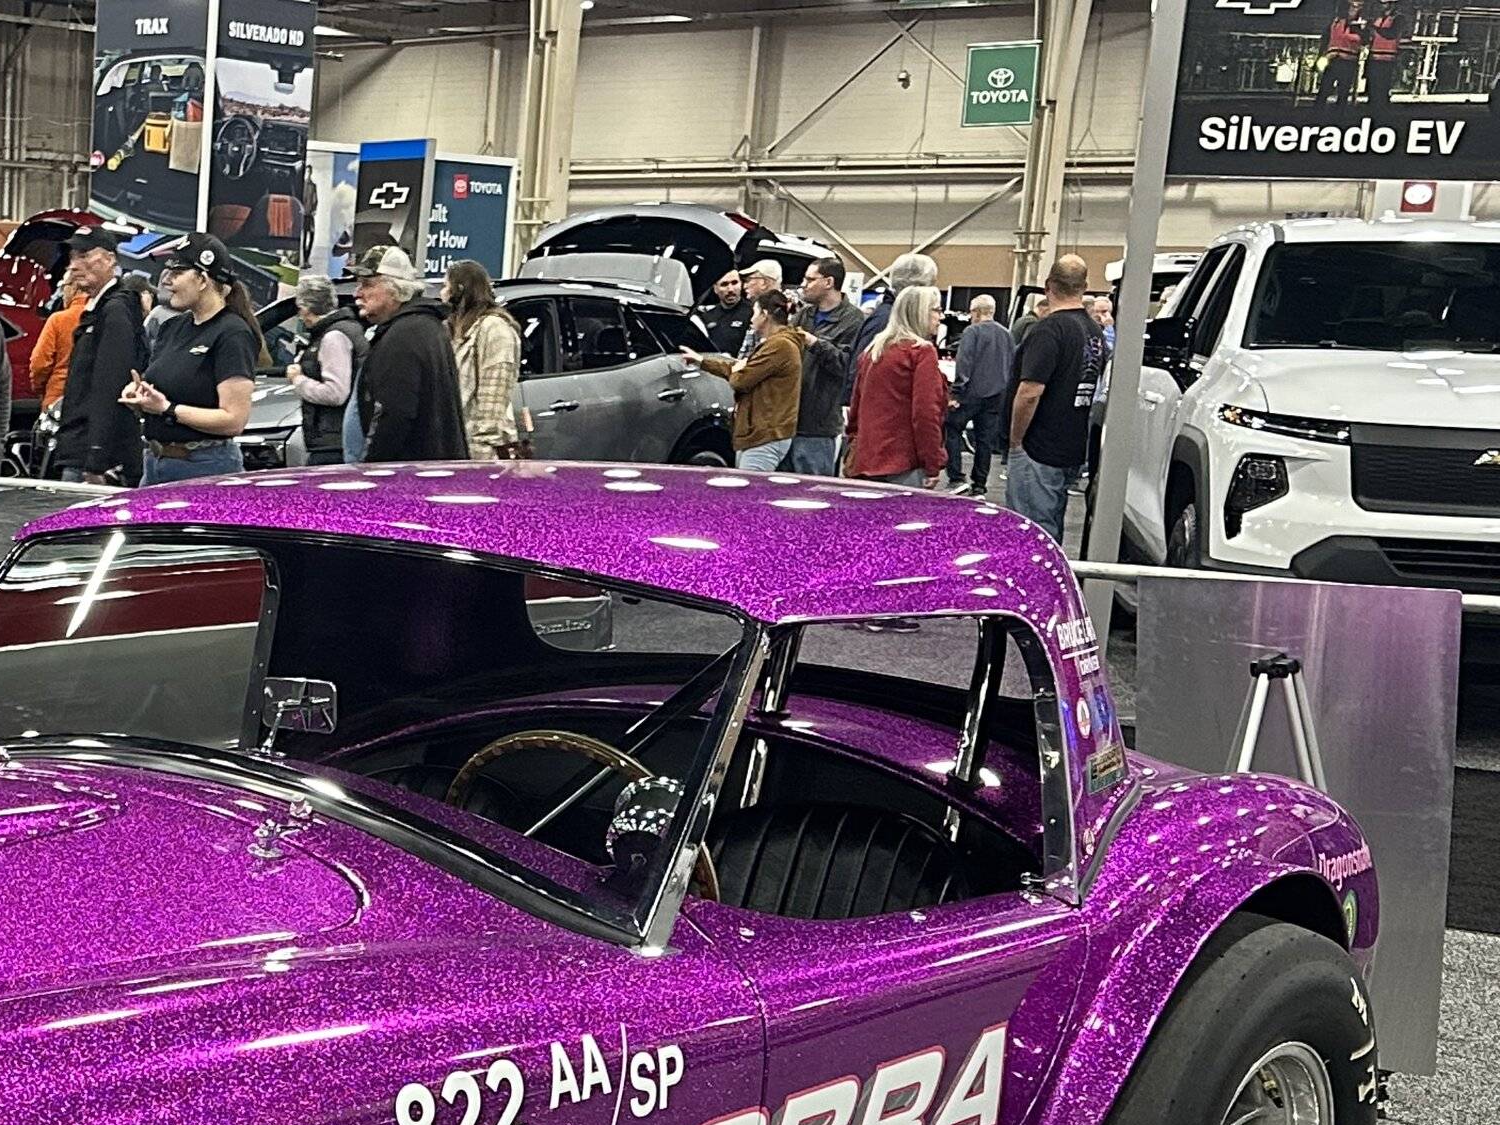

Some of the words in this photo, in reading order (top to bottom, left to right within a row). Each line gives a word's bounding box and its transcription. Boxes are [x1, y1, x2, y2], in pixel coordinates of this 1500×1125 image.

[136, 18, 169, 35] TRAX
[229, 21, 287, 44] SILVERADO
[289, 30, 304, 46] HD
[970, 89, 1029, 104] TOYOTA
[1199, 115, 1396, 154] Silverado
[1406, 120, 1466, 154] EV
[469, 181, 503, 195] TOYOTA
[428, 203, 448, 223] uilt
[426, 234, 438, 248] or
[439, 230, 468, 249] How
[424, 259, 439, 273] ou
